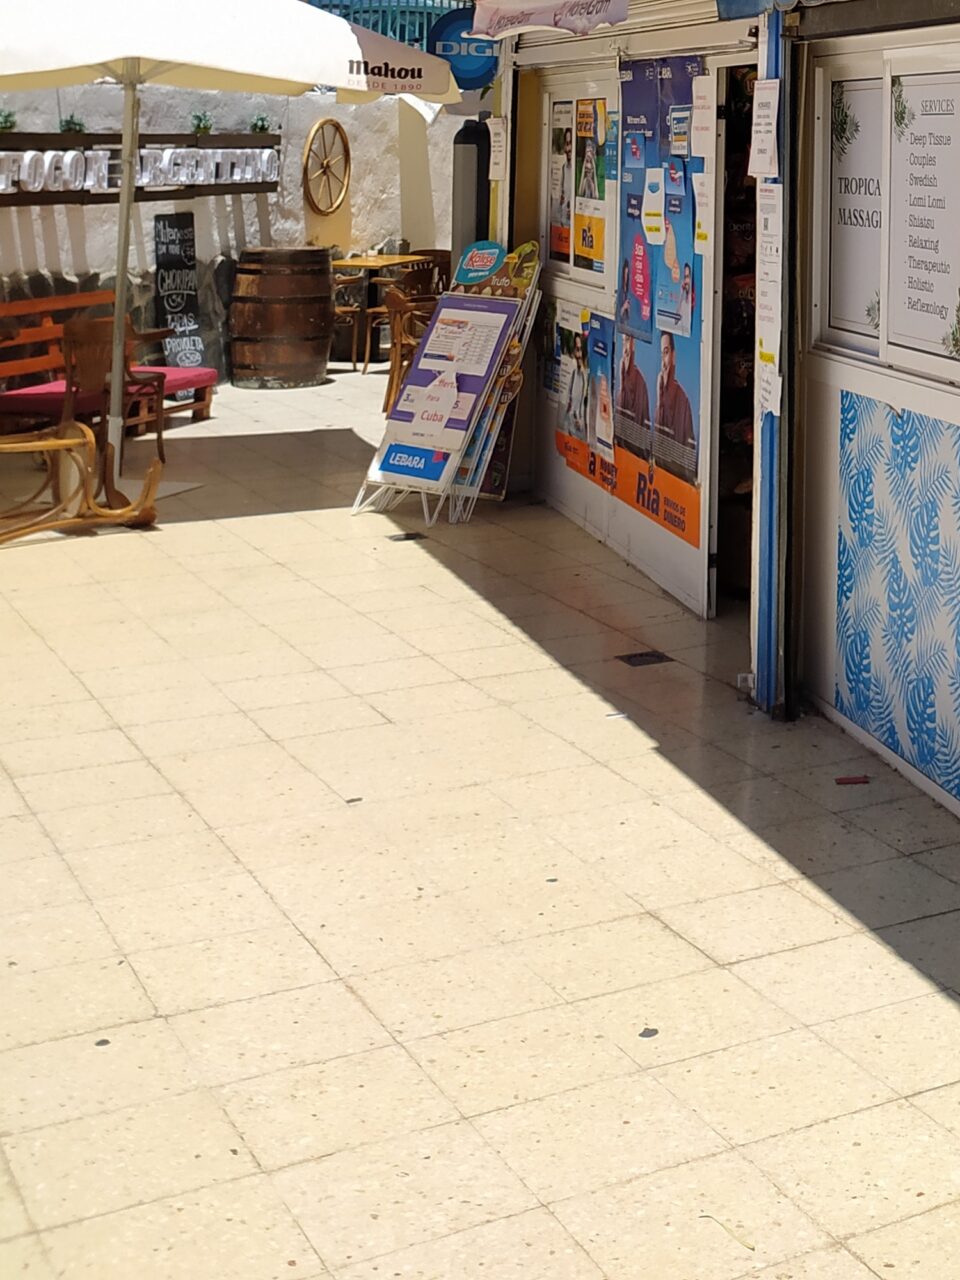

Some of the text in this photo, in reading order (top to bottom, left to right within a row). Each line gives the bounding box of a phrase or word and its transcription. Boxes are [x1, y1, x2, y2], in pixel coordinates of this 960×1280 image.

[435, 41, 500, 57] DIGI
[348, 59, 423, 80] mahou
[394, 83, 422, 91] 1890
[920, 99, 955, 114] SERVICES
[909, 132, 952, 148] Deep Tissue
[909, 153, 937, 169] Couples
[837, 176, 882, 197] TROPICA
[909, 173, 938, 188] Swedish
[908, 194, 946, 210] Lomi Lomi
[908, 214, 935, 230] Shiatsu
[581, 224, 594, 250] Ria
[908, 235, 940, 253] Relaxing
[465, 248, 497, 267] Kalise
[907, 255, 951, 275] Therapeutic
[907, 276, 935, 293] Holistic
[907, 297, 950, 320] Reflexology
[420, 410, 444, 422] Cuba
[389, 452, 426, 469] LEBARA
[636, 465, 660, 517] Ria
[663, 509, 686, 532] DINERO
